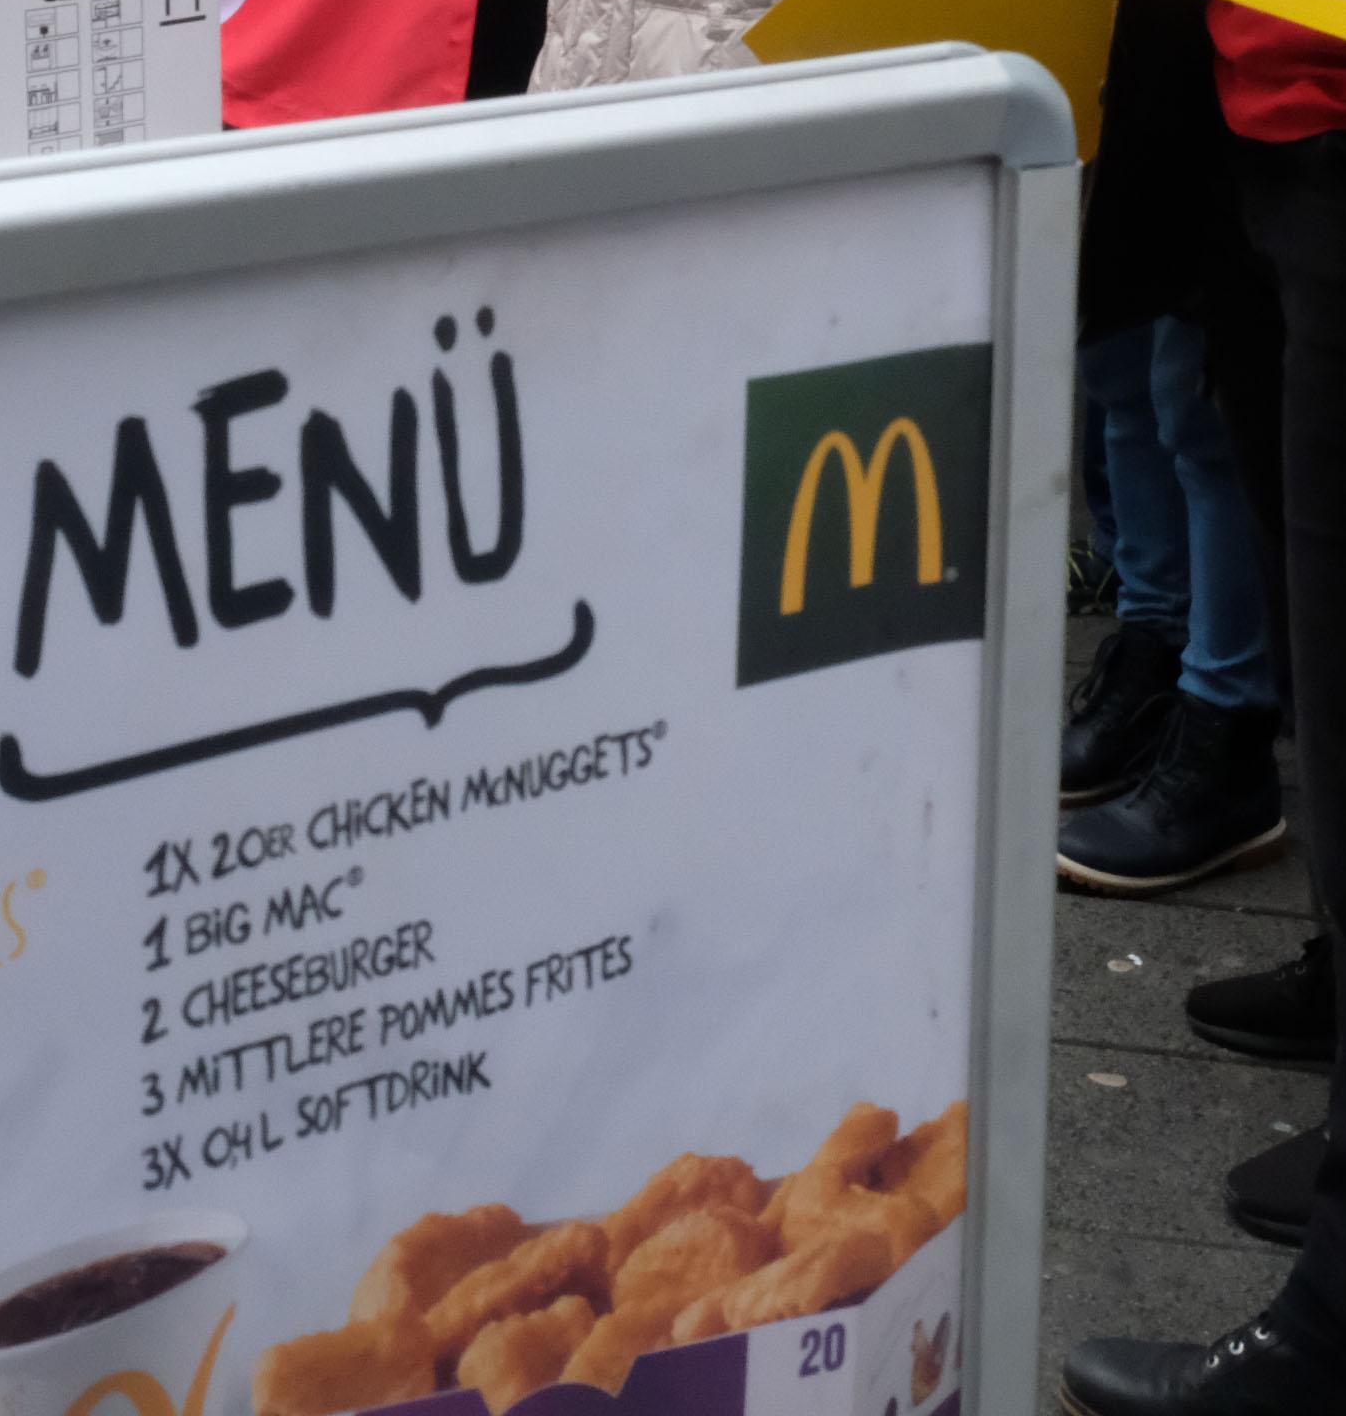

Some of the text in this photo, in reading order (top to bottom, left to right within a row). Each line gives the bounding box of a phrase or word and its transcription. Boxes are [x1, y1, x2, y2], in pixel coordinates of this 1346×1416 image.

[14, 304, 525, 678] MENÜ
[143, 840, 200, 898] 1X
[212, 822, 298, 880] 20ER
[141, 919, 435, 1044] 2 CHEESEBURGER
[143, 915, 171, 973] 1
[142, 1072, 166, 1117] 3
[380, 967, 514, 1047] POMMES
[142, 1134, 192, 1193] 3X
[800, 1322, 846, 1377] 20
